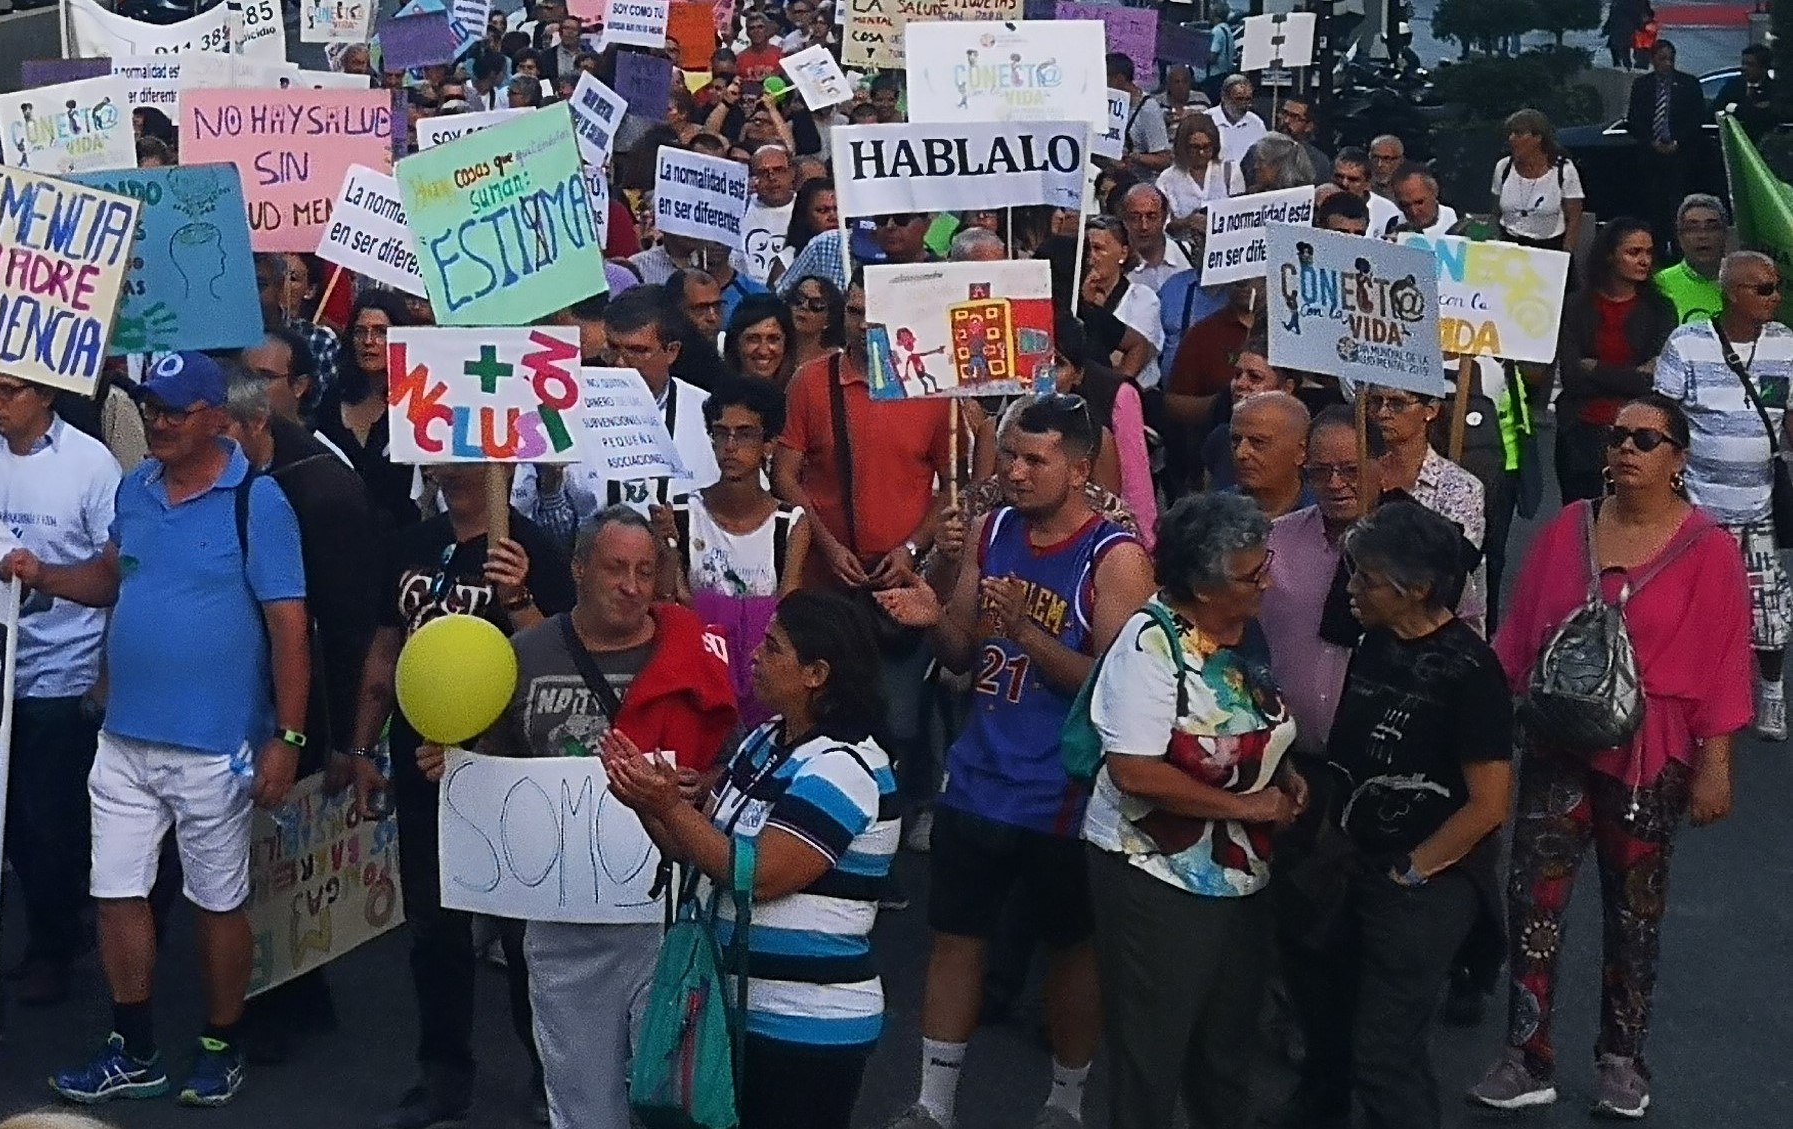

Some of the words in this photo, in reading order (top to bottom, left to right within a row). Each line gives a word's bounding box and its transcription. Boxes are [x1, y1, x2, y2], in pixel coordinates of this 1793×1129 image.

[194, 104, 242, 140] NO
[251, 103, 305, 135] HAY
[306, 105, 392, 138] SALUD
[254, 150, 309, 185] SIN
[453, 162, 491, 189] cosas
[493, 151, 514, 178] que
[659, 156, 672, 181] La
[673, 164, 727, 195] normalidad
[849, 134, 1081, 181] HABLALO
[344, 176, 364, 208] La
[658, 196, 672, 216] en
[674, 198, 693, 220] ser
[1211, 211, 1224, 235] La
[1287, 198, 1313, 224] está
[329, 221, 352, 247] en
[351, 234, 379, 256] ser
[1207, 251, 1224, 269] en
[1225, 246, 1245, 267] ser
[1348, 313, 1403, 348] VIDA
[975, 644, 1031, 704] 21
[446, 761, 662, 908] SOMO
